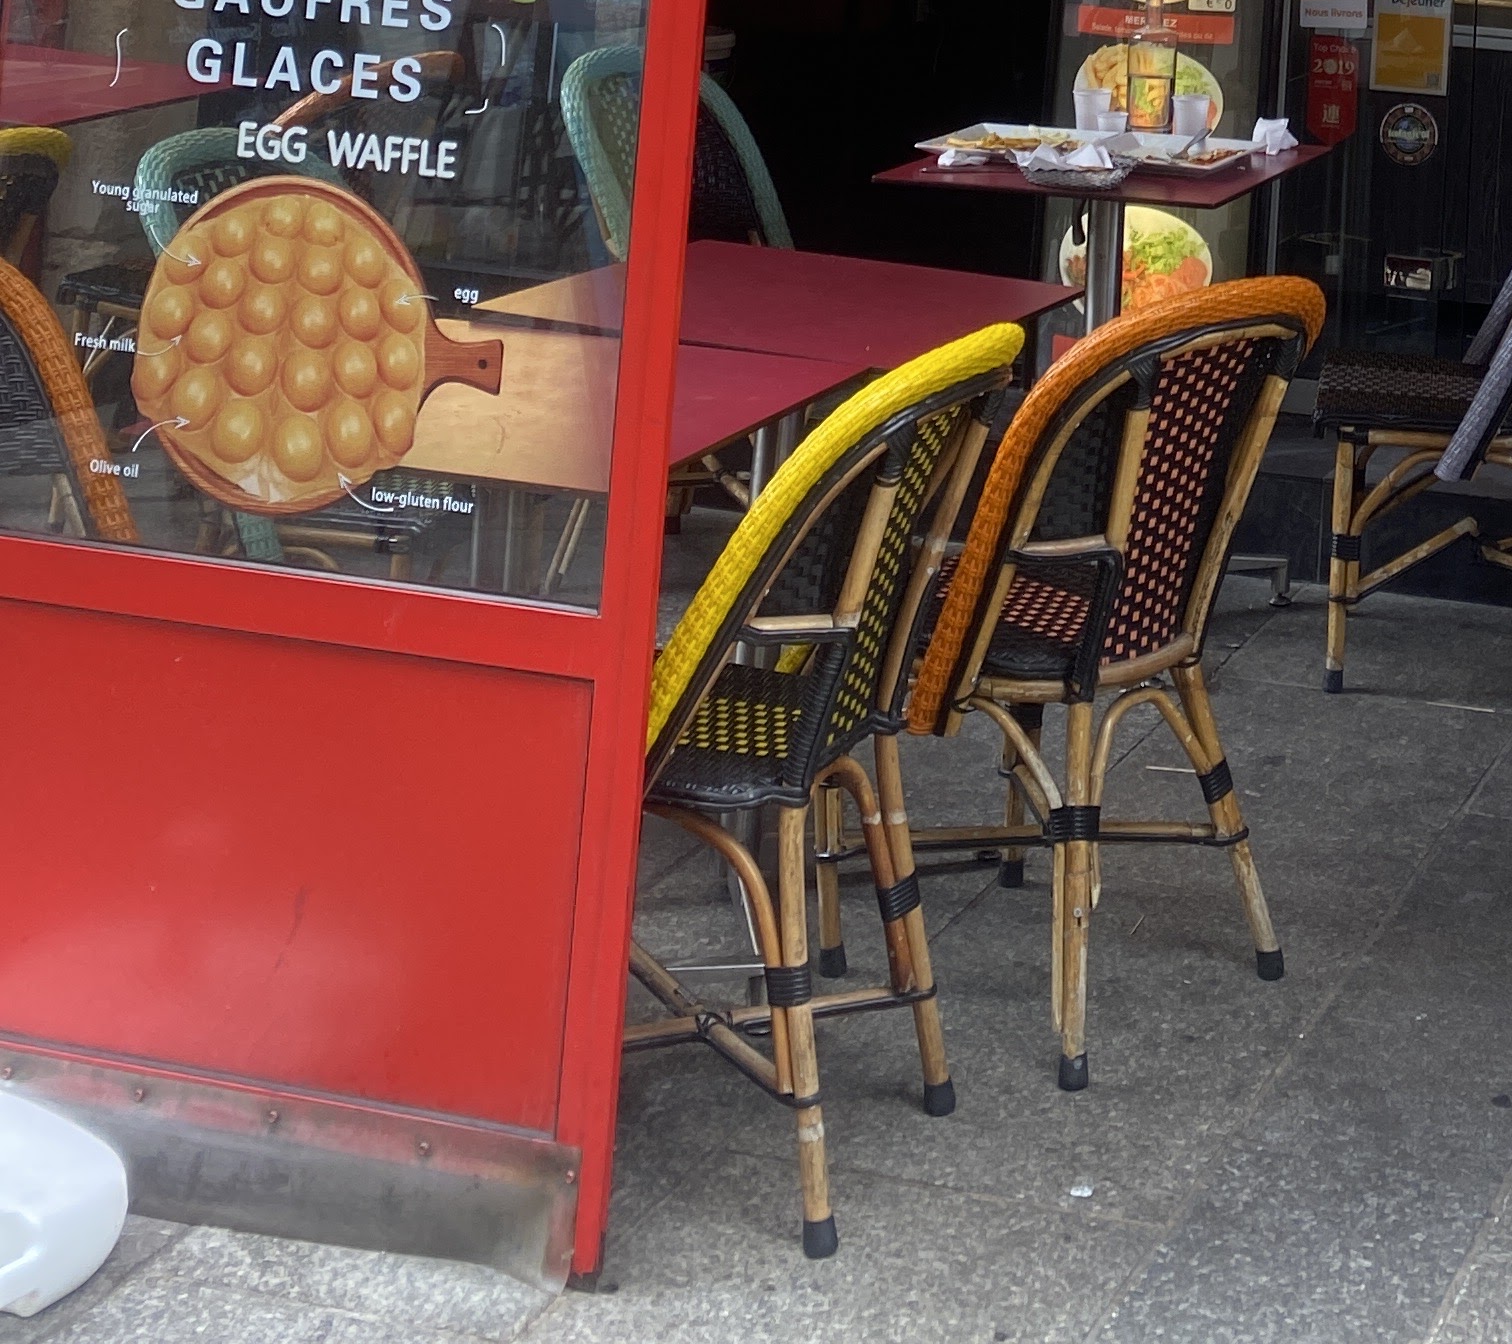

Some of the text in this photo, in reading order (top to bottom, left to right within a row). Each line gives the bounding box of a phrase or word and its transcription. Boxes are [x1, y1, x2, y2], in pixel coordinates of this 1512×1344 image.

[1124, 14, 1178, 28] MEREZ
[1304, 7, 1364, 18] Nous livrons
[186, 38, 423, 103] GLACES
[236, 121, 458, 180] EGG WAFFLE
[91, 179, 199, 206] Young granulated
[125, 199, 160, 215] sugar
[454, 286, 479, 305] egg
[74, 332, 136, 353] Fresh milk
[89, 458, 139, 479] Olive oil
[371, 487, 475, 515] low-gluten flour
